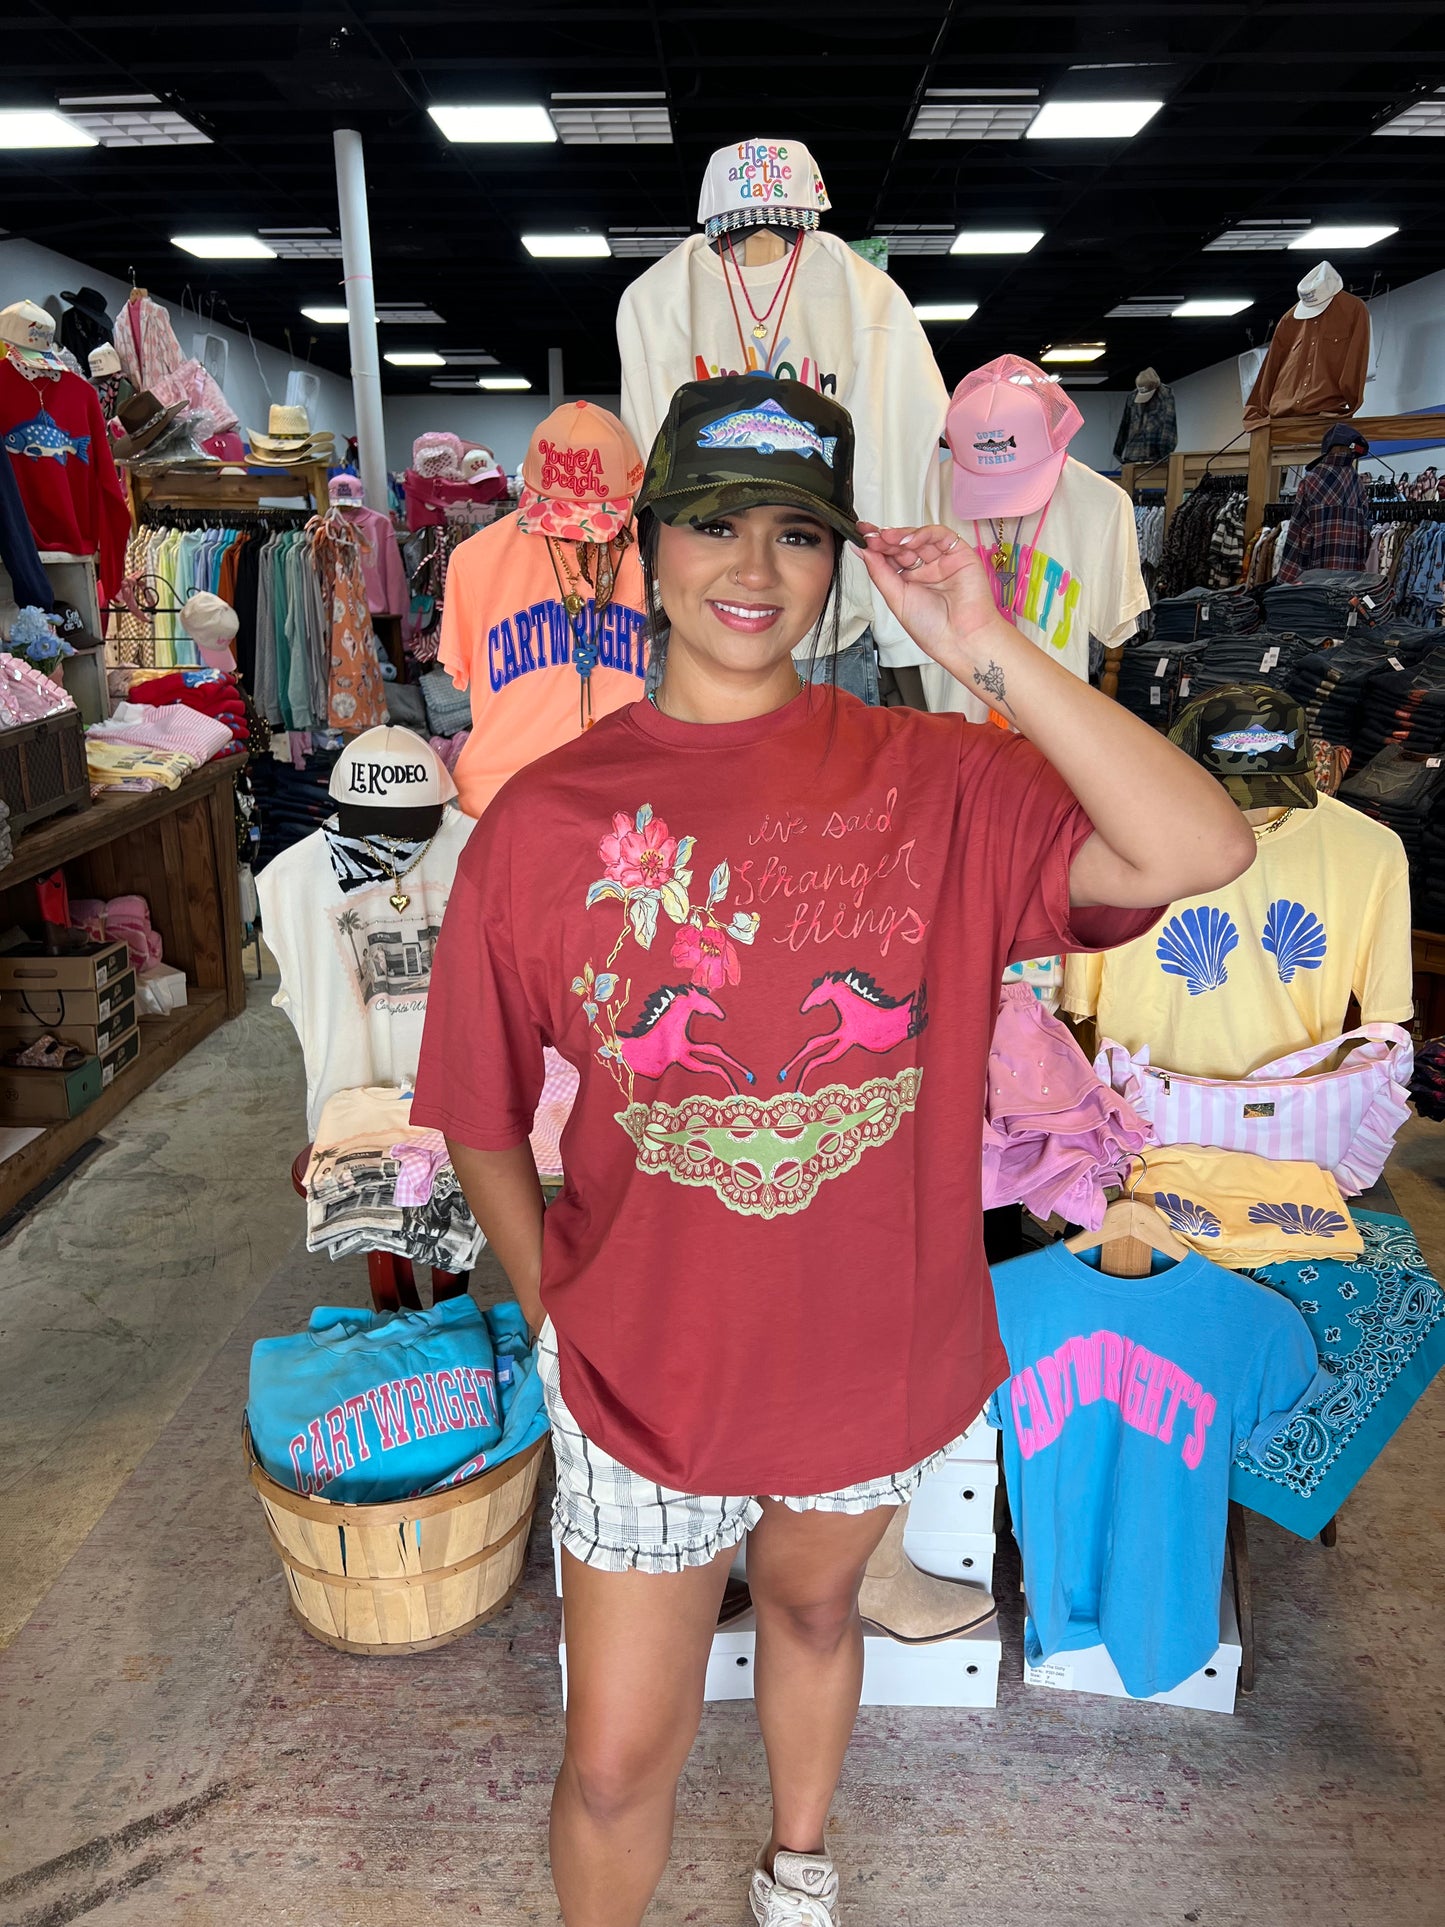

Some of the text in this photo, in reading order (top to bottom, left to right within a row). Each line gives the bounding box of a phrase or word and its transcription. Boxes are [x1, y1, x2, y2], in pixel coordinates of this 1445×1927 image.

[737, 142, 788, 168] these
[728, 160, 793, 183] are the
[740, 178, 788, 202] days.
[976, 430, 1005, 440] GONE
[977, 453, 1016, 465] FISHIN
[541, 464, 609, 497] Peach
[822, 787, 898, 839] said
[772, 900, 930, 957] things
[289, 1366, 499, 1496] CARTWRIGHT
